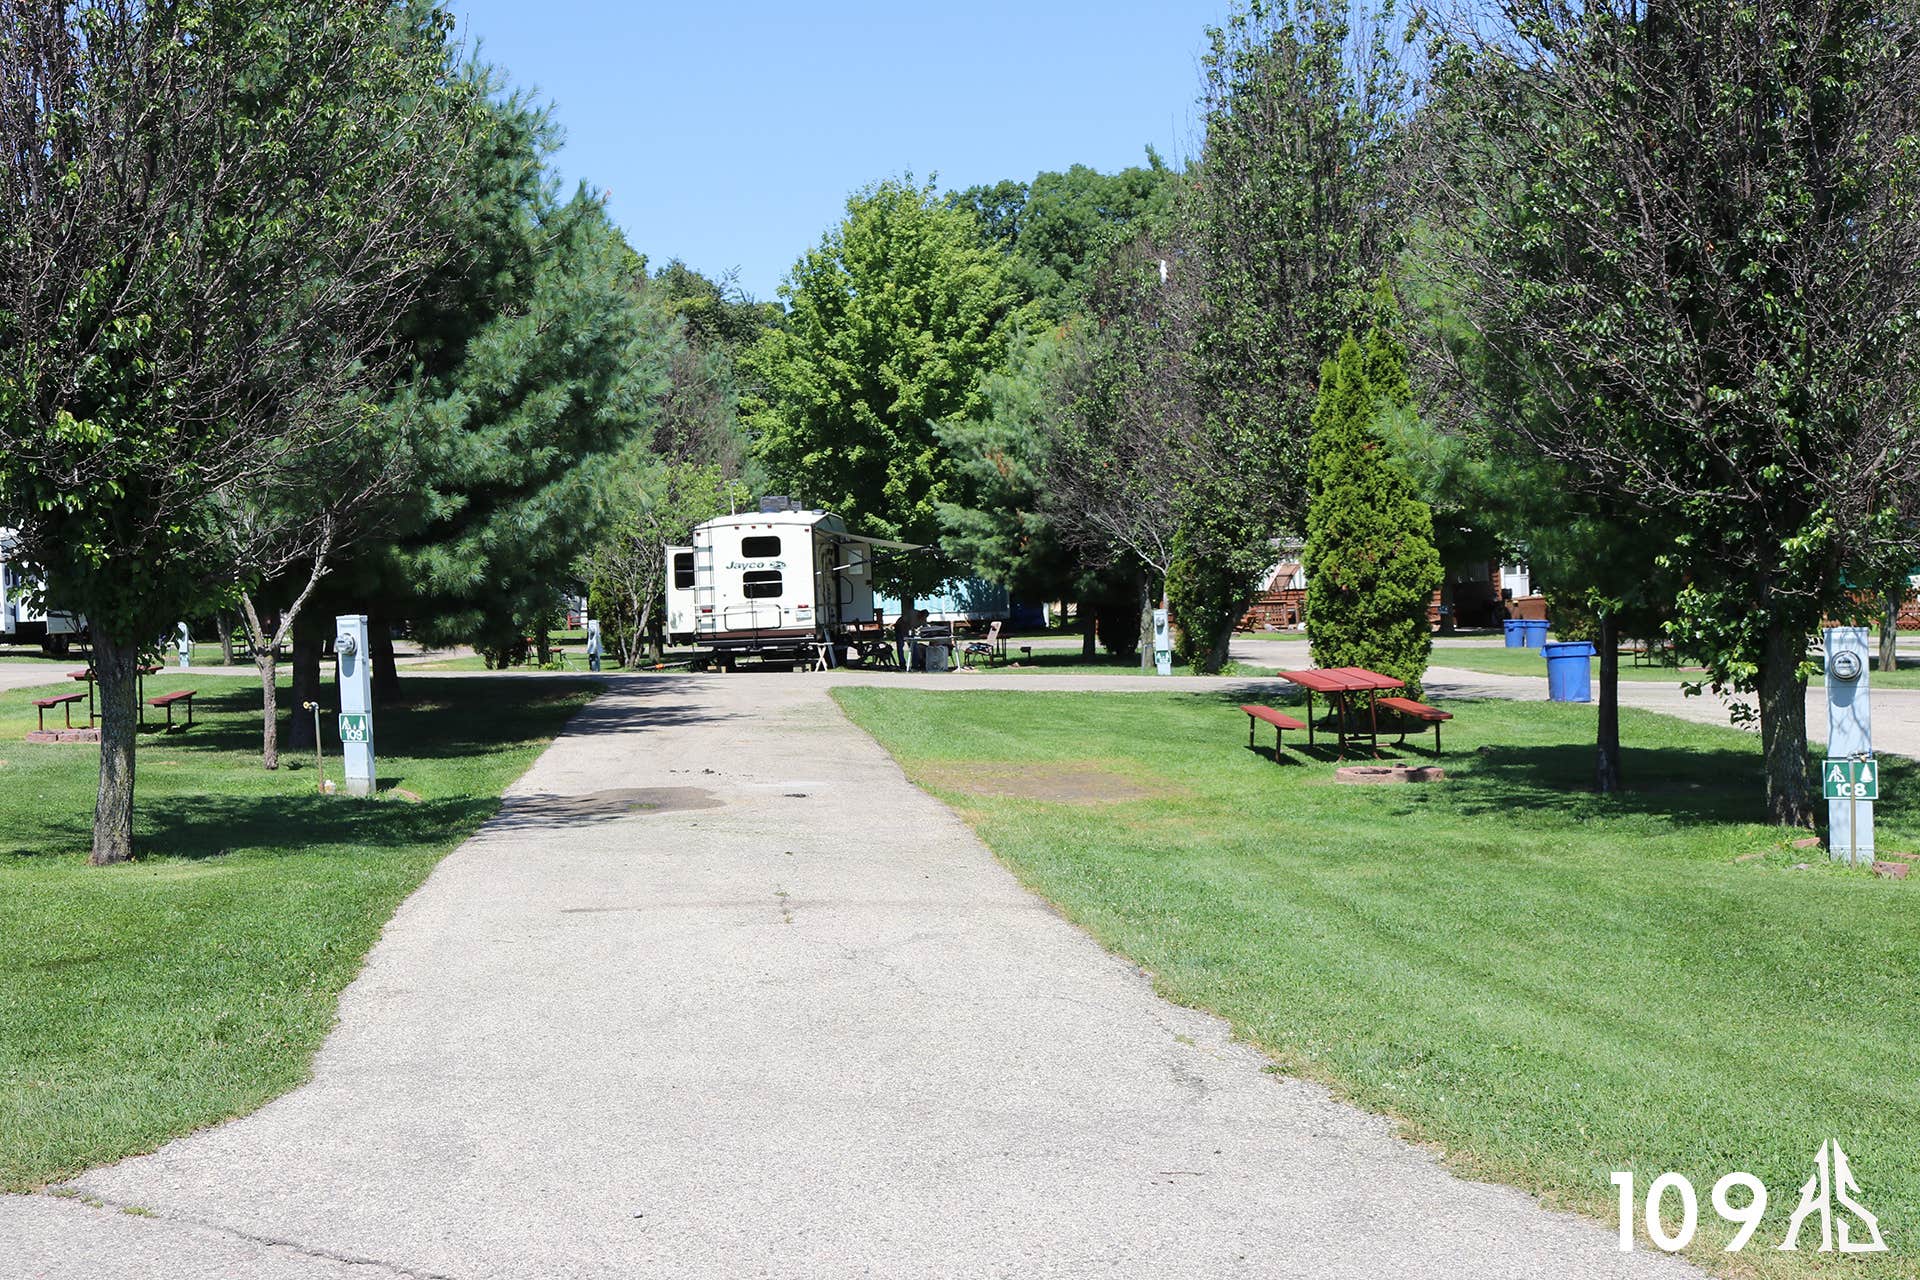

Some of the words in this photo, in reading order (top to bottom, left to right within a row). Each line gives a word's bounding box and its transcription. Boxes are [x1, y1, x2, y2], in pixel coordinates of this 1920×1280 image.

[726, 561, 765, 570] Jayco
[346, 730, 363, 740] 109
[1836, 783, 1867, 797] 108
